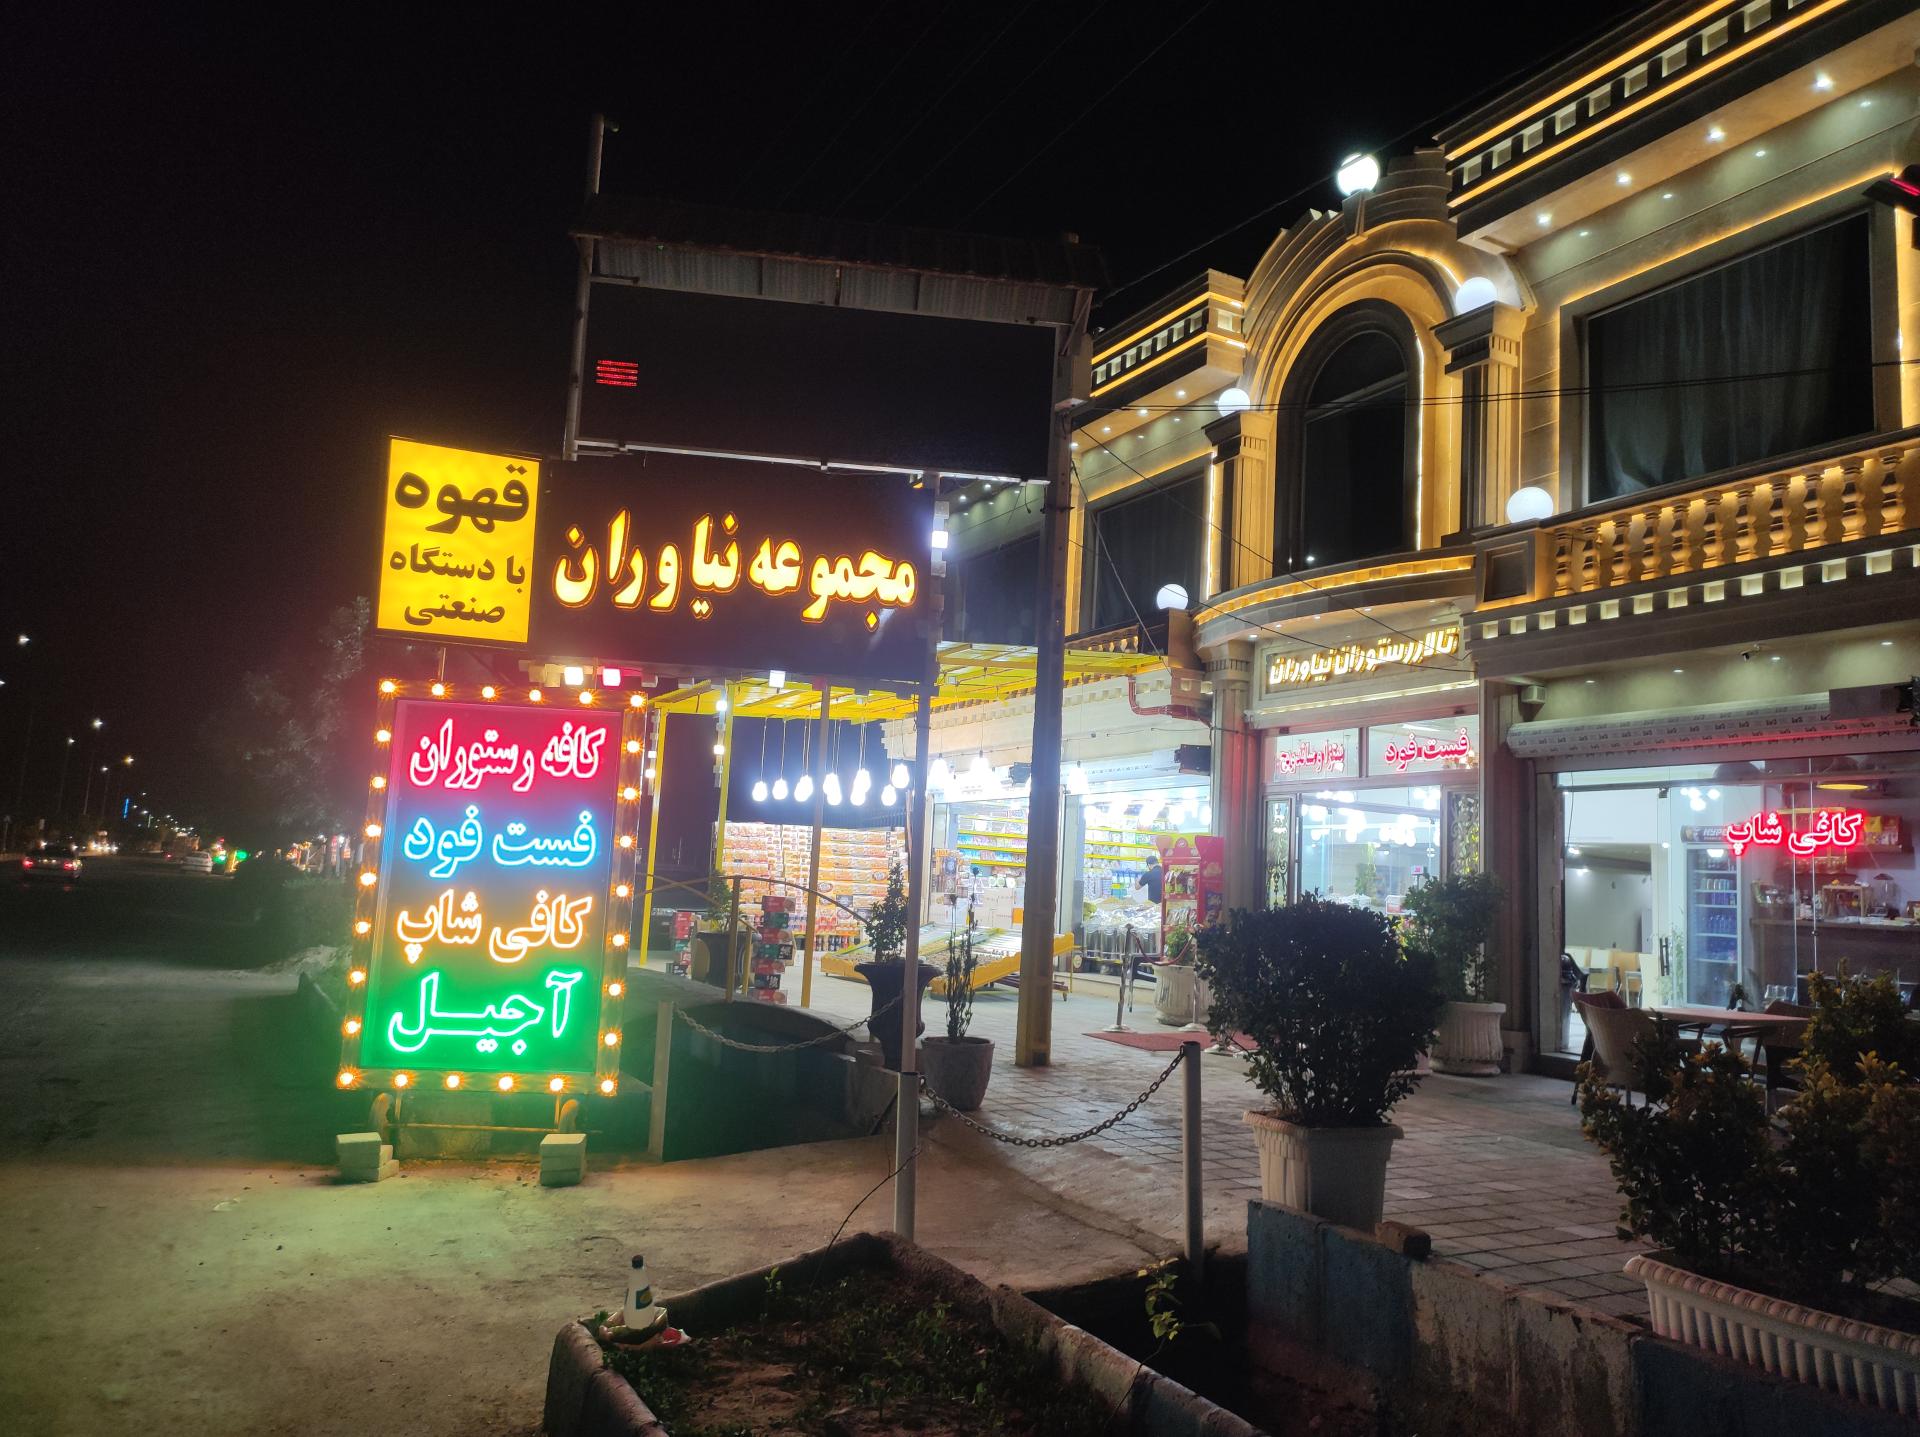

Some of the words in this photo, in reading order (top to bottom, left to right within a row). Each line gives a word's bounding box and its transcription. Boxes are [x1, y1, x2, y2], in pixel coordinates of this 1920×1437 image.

[395, 464, 529, 534] قهوه
[389, 543, 495, 581] دستگاه
[506, 555, 526, 593] با
[748, 536, 918, 631] مجموعه
[404, 594, 505, 626] صنعتی
[1269, 648, 1336, 684] نیاوران
[1333, 638, 1412, 675] رستوران
[410, 718, 535, 792] رستوران
[541, 722, 606, 778] کافه
[1384, 732, 1418, 772] فود
[1422, 727, 1470, 761] فست
[404, 805, 483, 878] فود
[492, 810, 596, 867] فست
[1727, 812, 1782, 855] شاپ
[1788, 811, 1862, 855] کافی
[397, 888, 482, 964] شاپ
[489, 890, 593, 962] کافی
[388, 970, 583, 1055] آجیل
